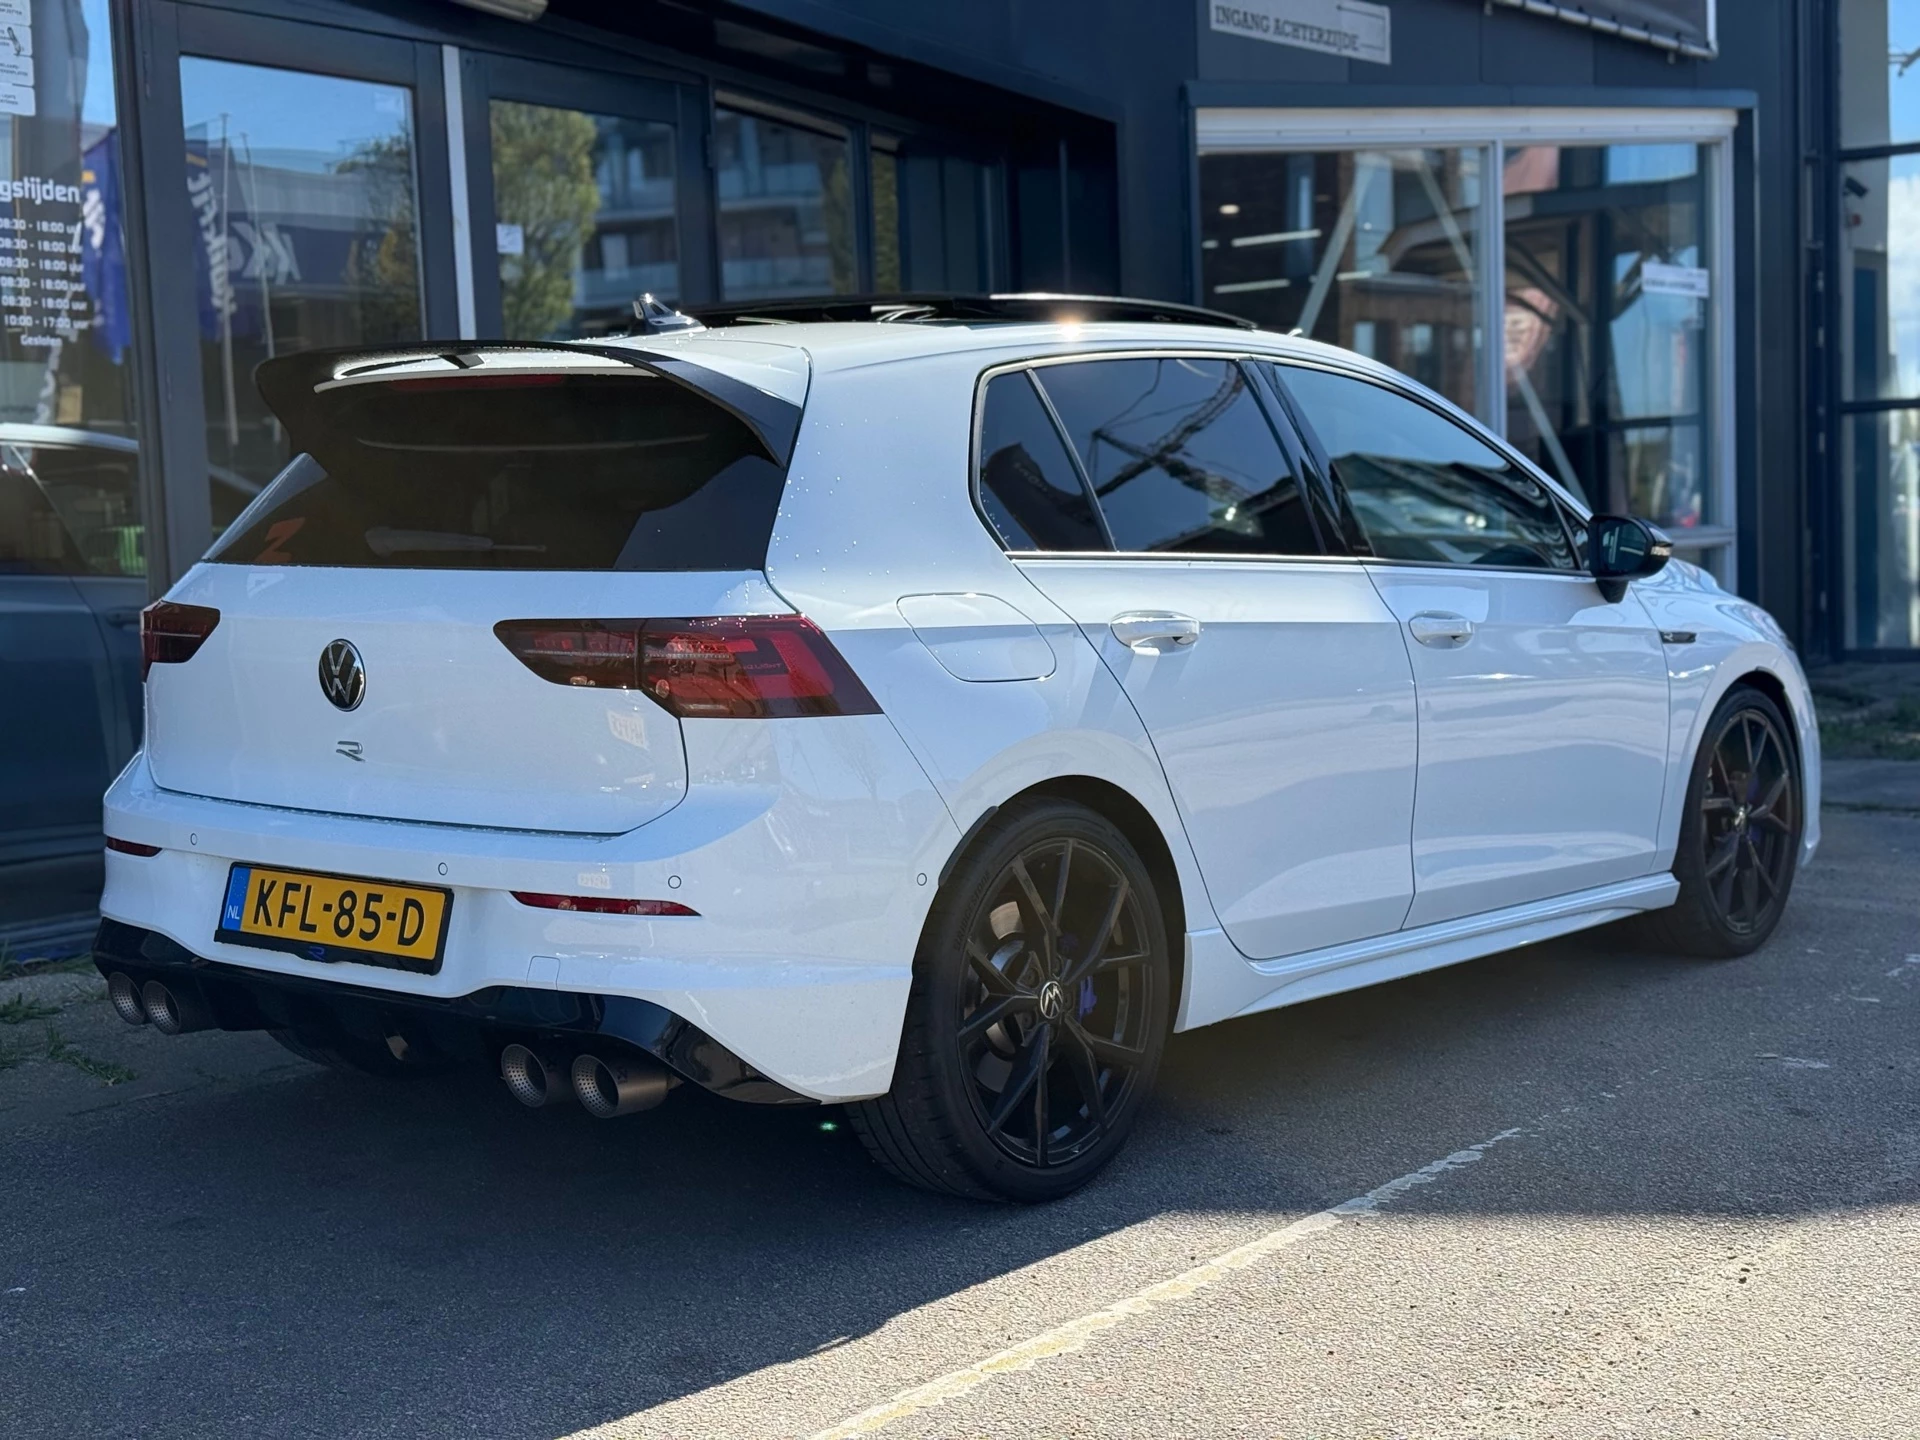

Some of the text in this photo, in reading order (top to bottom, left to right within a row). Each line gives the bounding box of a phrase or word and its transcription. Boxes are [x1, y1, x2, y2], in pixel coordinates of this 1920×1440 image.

[1215, 5, 1360, 52] INGANG ACHTERZIJDE
[36, 220, 64, 233] 18:00
[38, 240, 66, 253] 18:00
[39, 259, 67, 271] 18:00
[0, 276, 30, 288] 08:30
[40, 278, 68, 291] 18:00
[70, 283, 86, 291] uur
[1, 295, 32, 307] 08:30
[41, 297, 70, 309] 18:00
[71, 301, 87, 310] uur
[4, 314, 33, 326] 10:00
[43, 316, 71, 329] 17:00
[227, 904, 241, 921] NL
[253, 878, 425, 947] KFL-85-D
